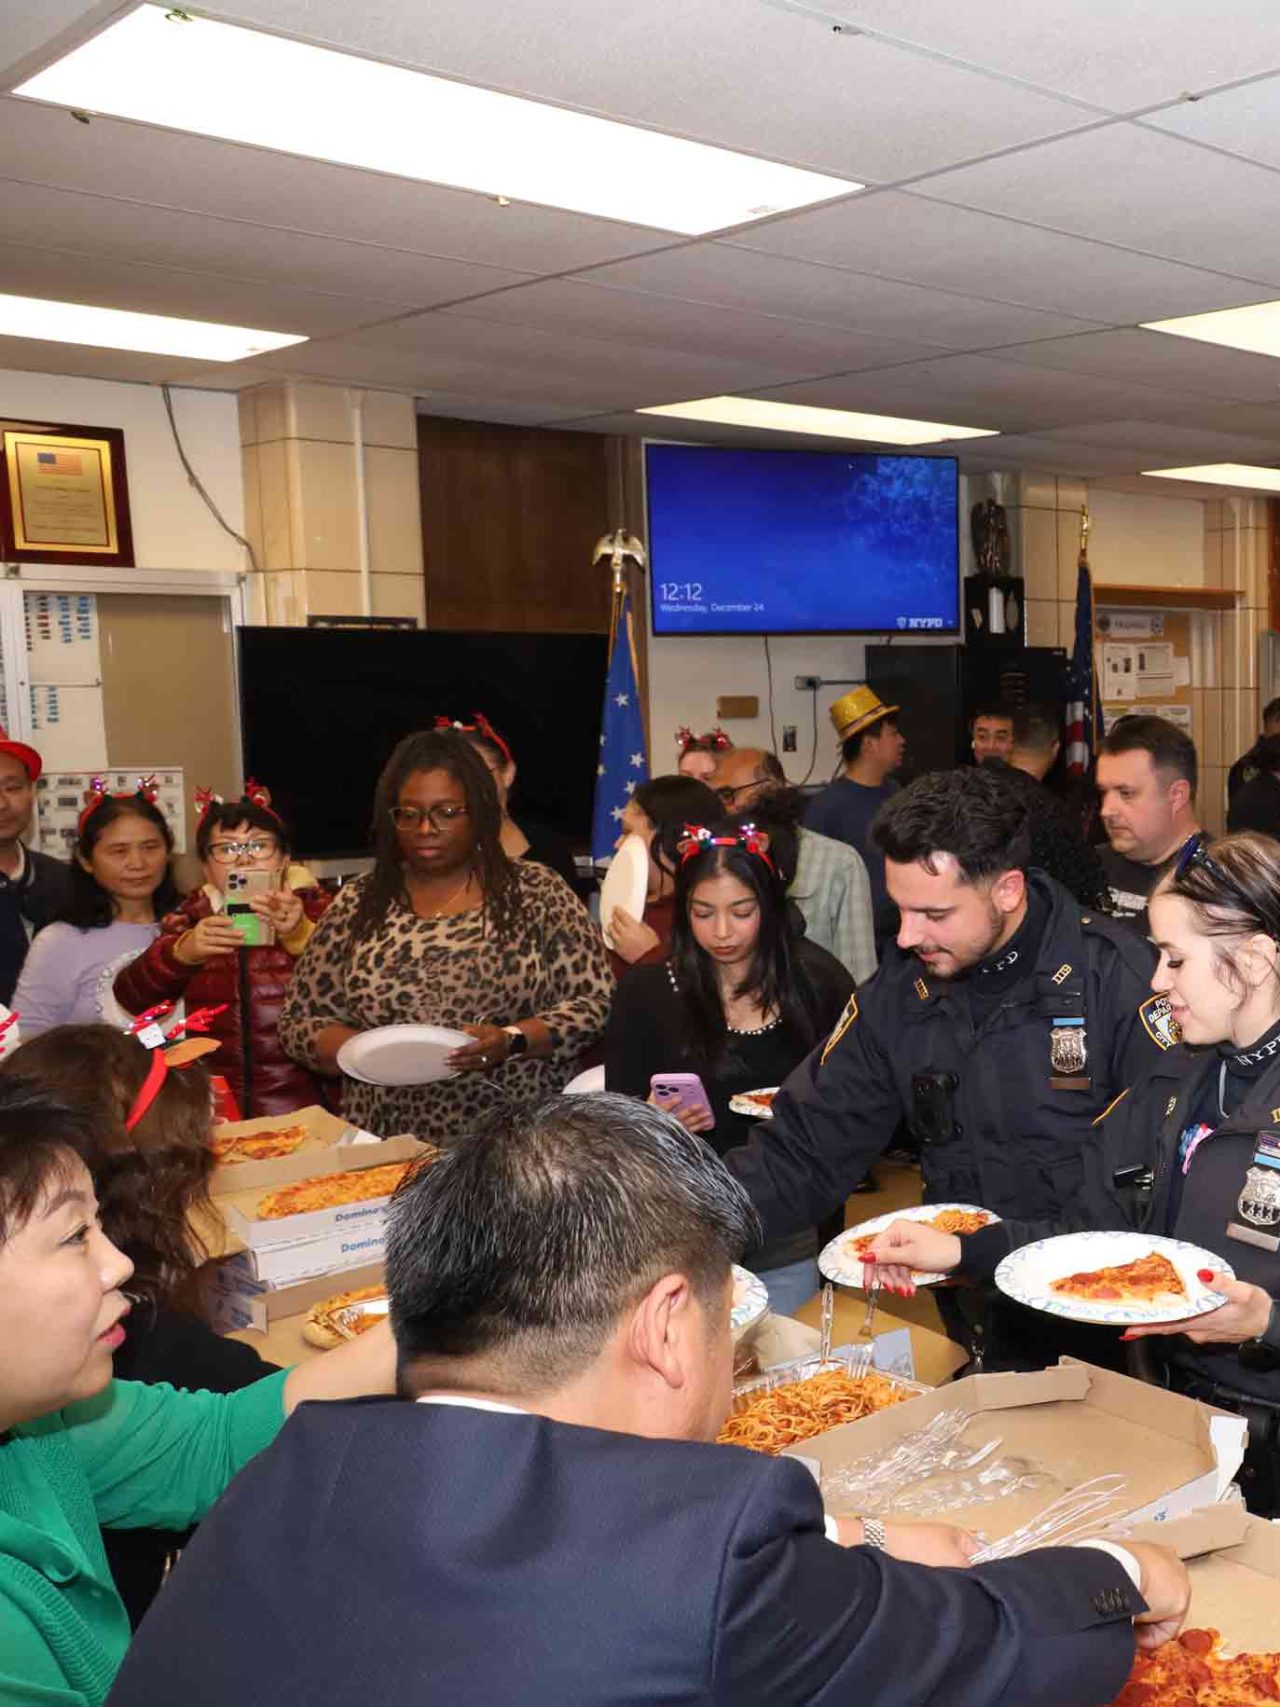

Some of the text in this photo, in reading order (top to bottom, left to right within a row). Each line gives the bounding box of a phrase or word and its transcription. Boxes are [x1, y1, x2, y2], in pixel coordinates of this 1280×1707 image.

[660, 583, 702, 600] 12:12
[909, 618, 943, 628] NYPD
[1148, 1004, 1172, 1024] DEPAR
[1155, 1031, 1172, 1048] CITY
